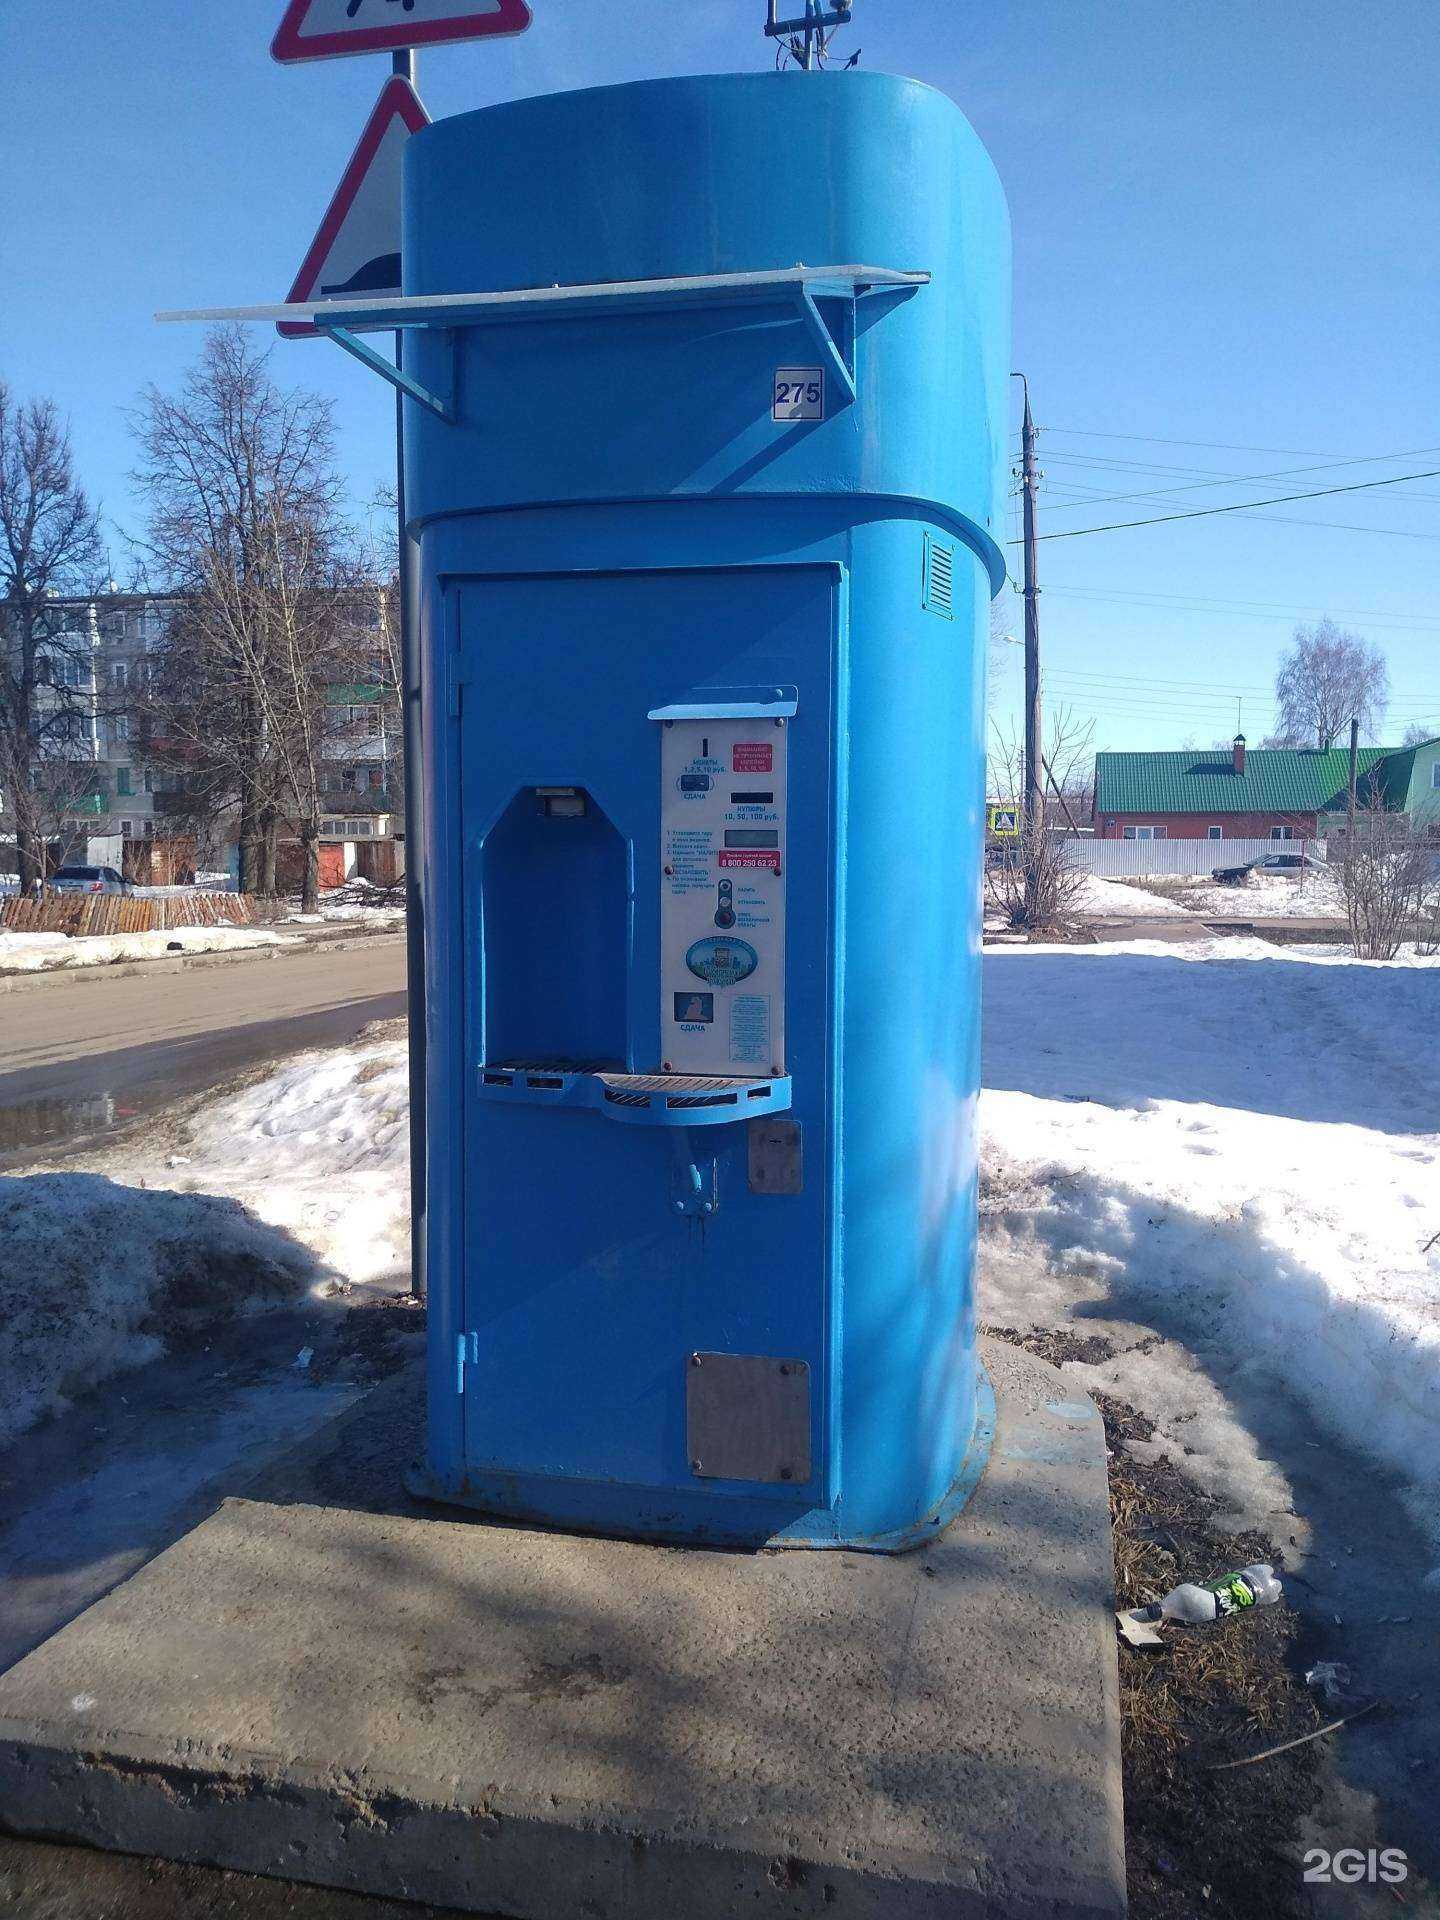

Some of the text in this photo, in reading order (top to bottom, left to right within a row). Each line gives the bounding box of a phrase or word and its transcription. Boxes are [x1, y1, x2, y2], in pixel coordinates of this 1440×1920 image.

[776, 383, 820, 403] 275
[684, 793, 706, 801] СДАЧА
[725, 813, 735, 821] 10,
[728, 859, 741, 867] 800
[742, 859, 756, 867] 250
[757, 859, 767, 867] 62
[768, 859, 777, 867] 23
[680, 1024, 706, 1032] СДАЧА
